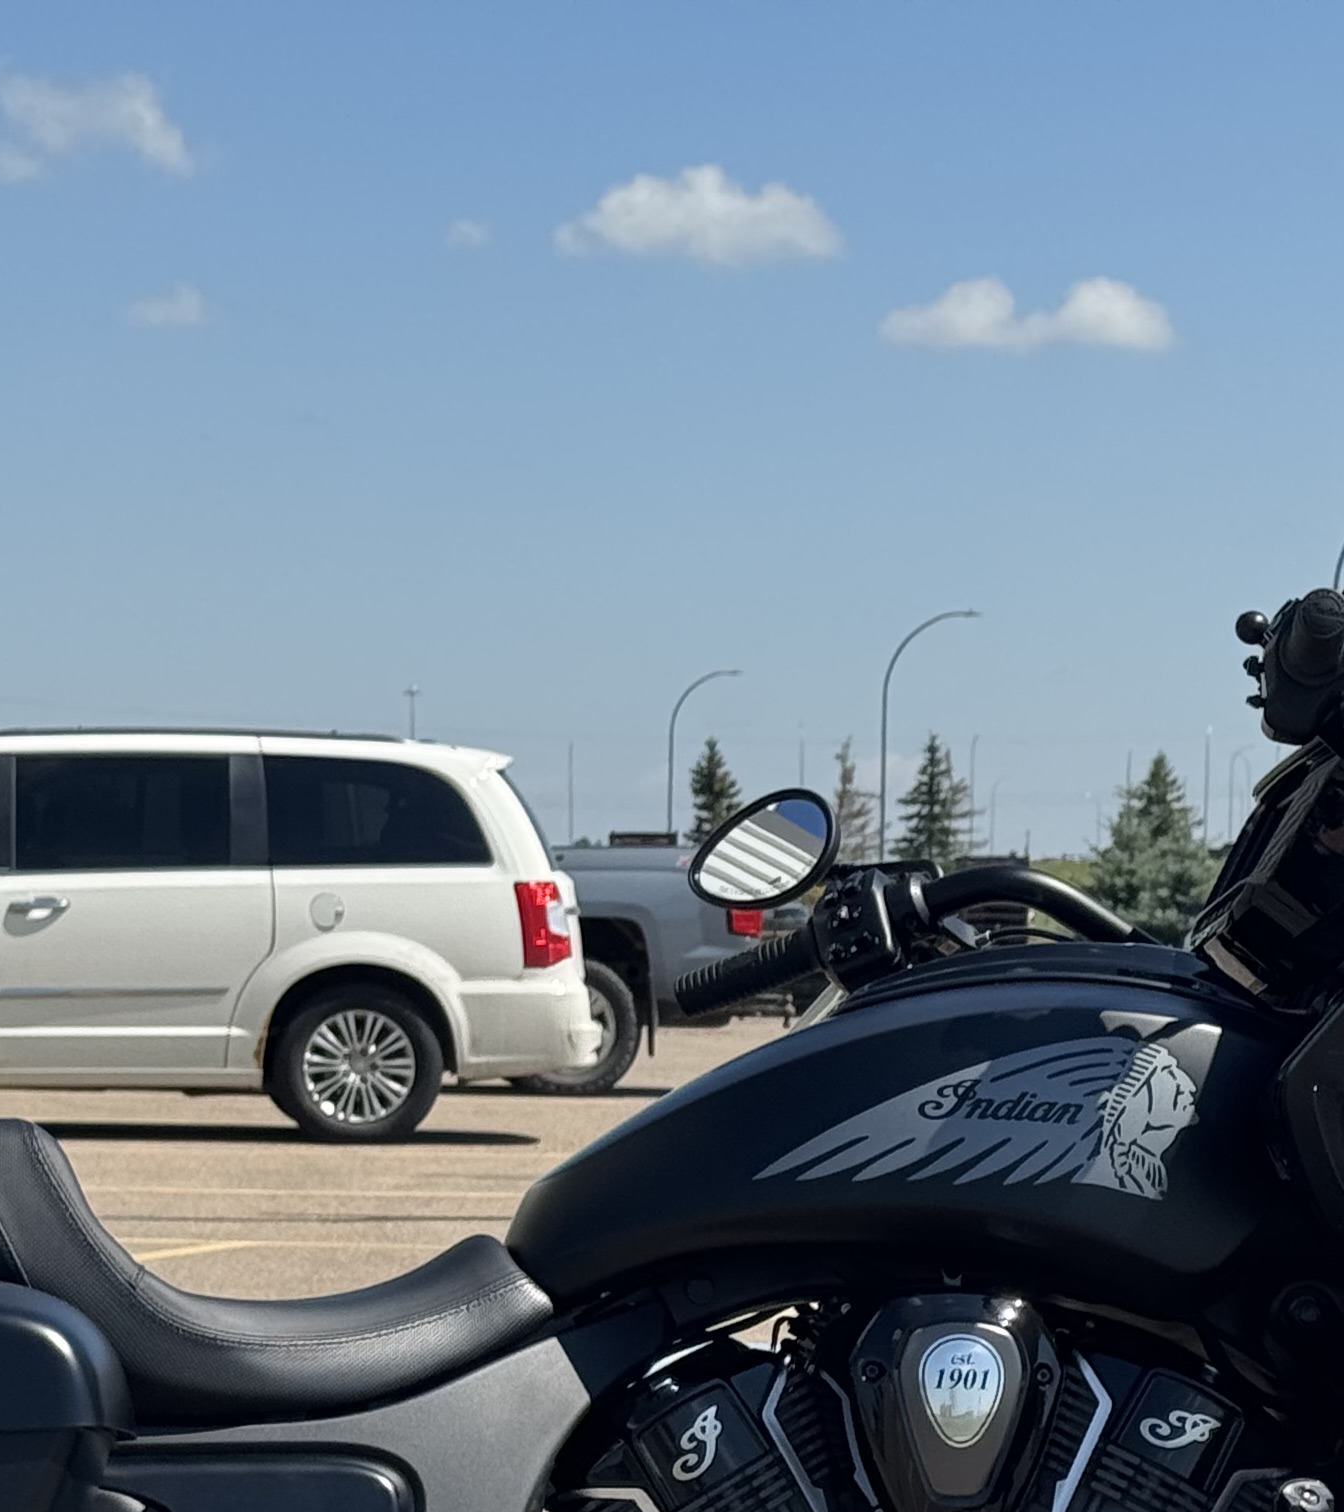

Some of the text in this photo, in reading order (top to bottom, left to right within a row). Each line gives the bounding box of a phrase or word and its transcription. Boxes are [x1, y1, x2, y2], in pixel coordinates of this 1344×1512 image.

[917, 1078, 1084, 1125] Indian
[950, 1352, 976, 1365] est.
[933, 1368, 991, 1390] 1901
